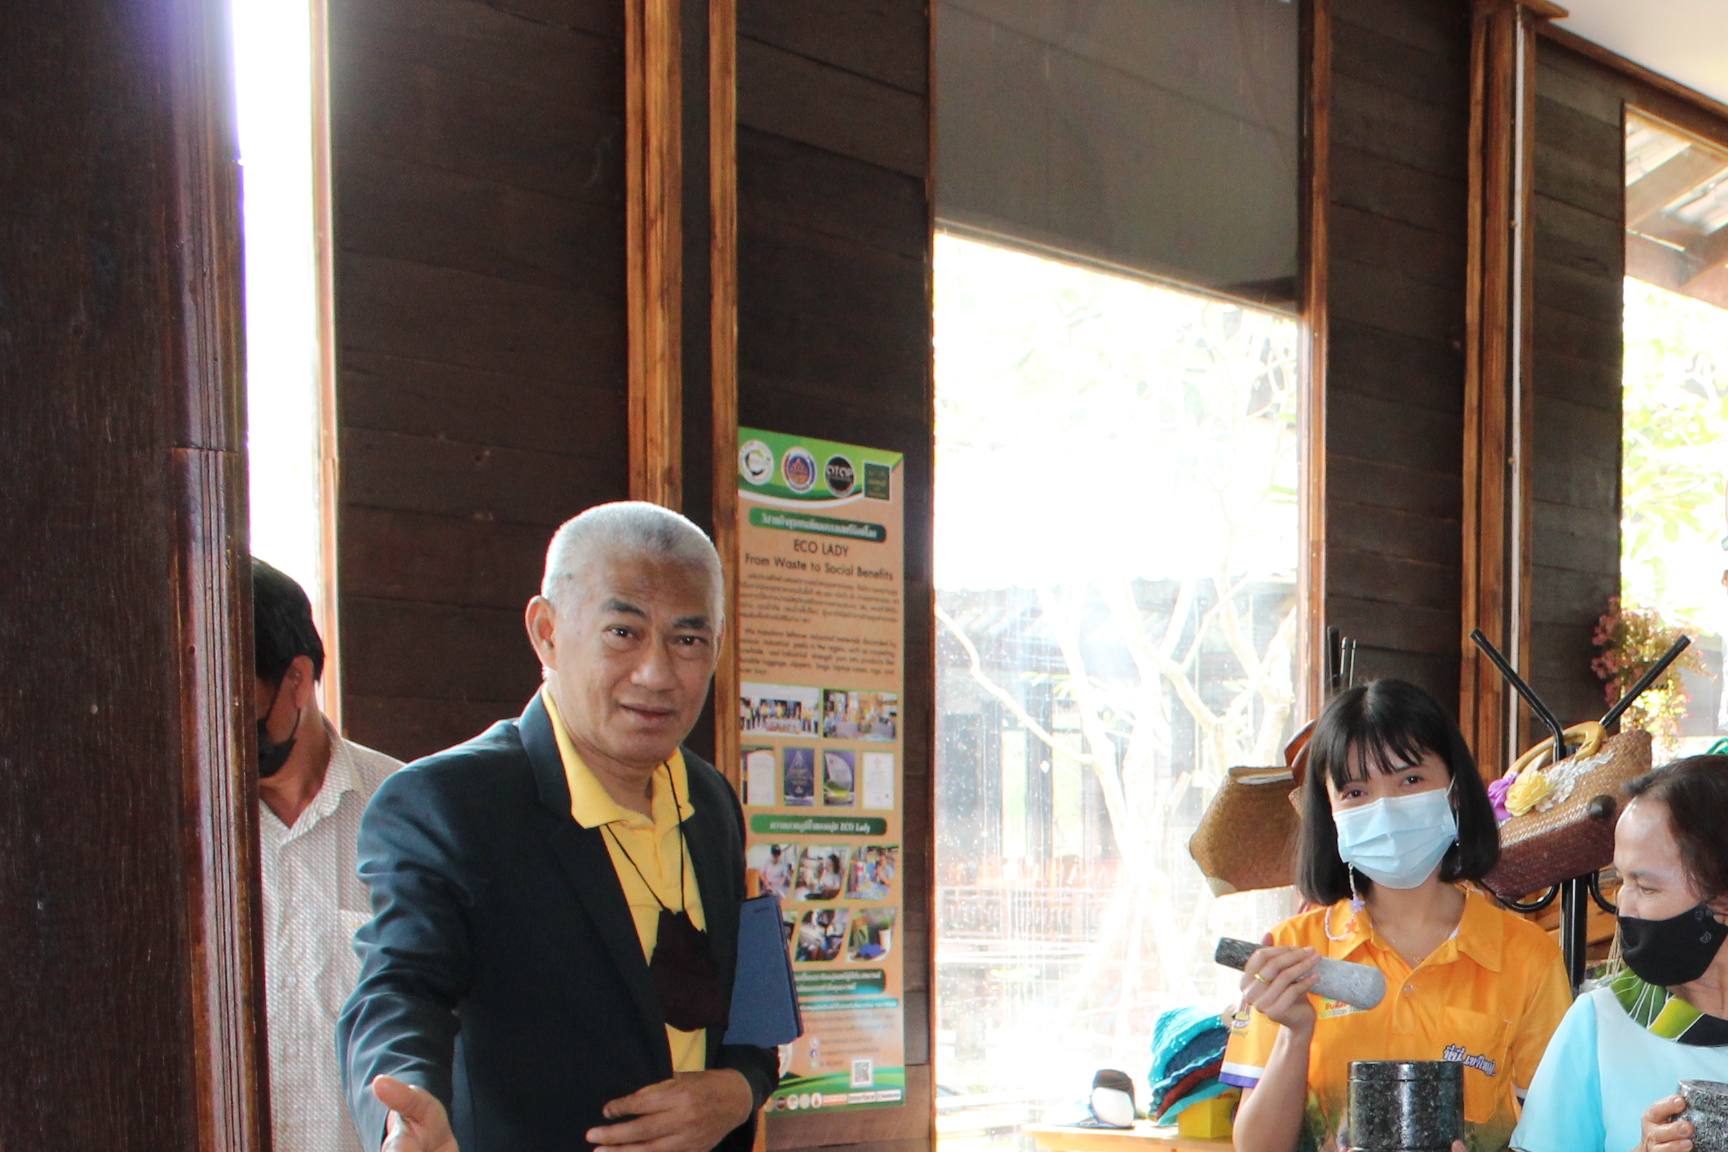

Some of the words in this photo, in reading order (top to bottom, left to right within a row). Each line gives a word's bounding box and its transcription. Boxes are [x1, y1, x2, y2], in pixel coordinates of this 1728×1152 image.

[794, 539, 818, 553] ECO
[821, 542, 849, 557] LADY
[745, 553, 770, 565] From
[774, 556, 807, 570] Waste
[810, 562, 821, 573] to
[824, 562, 854, 576] Social
[857, 566, 893, 581] Benefits
